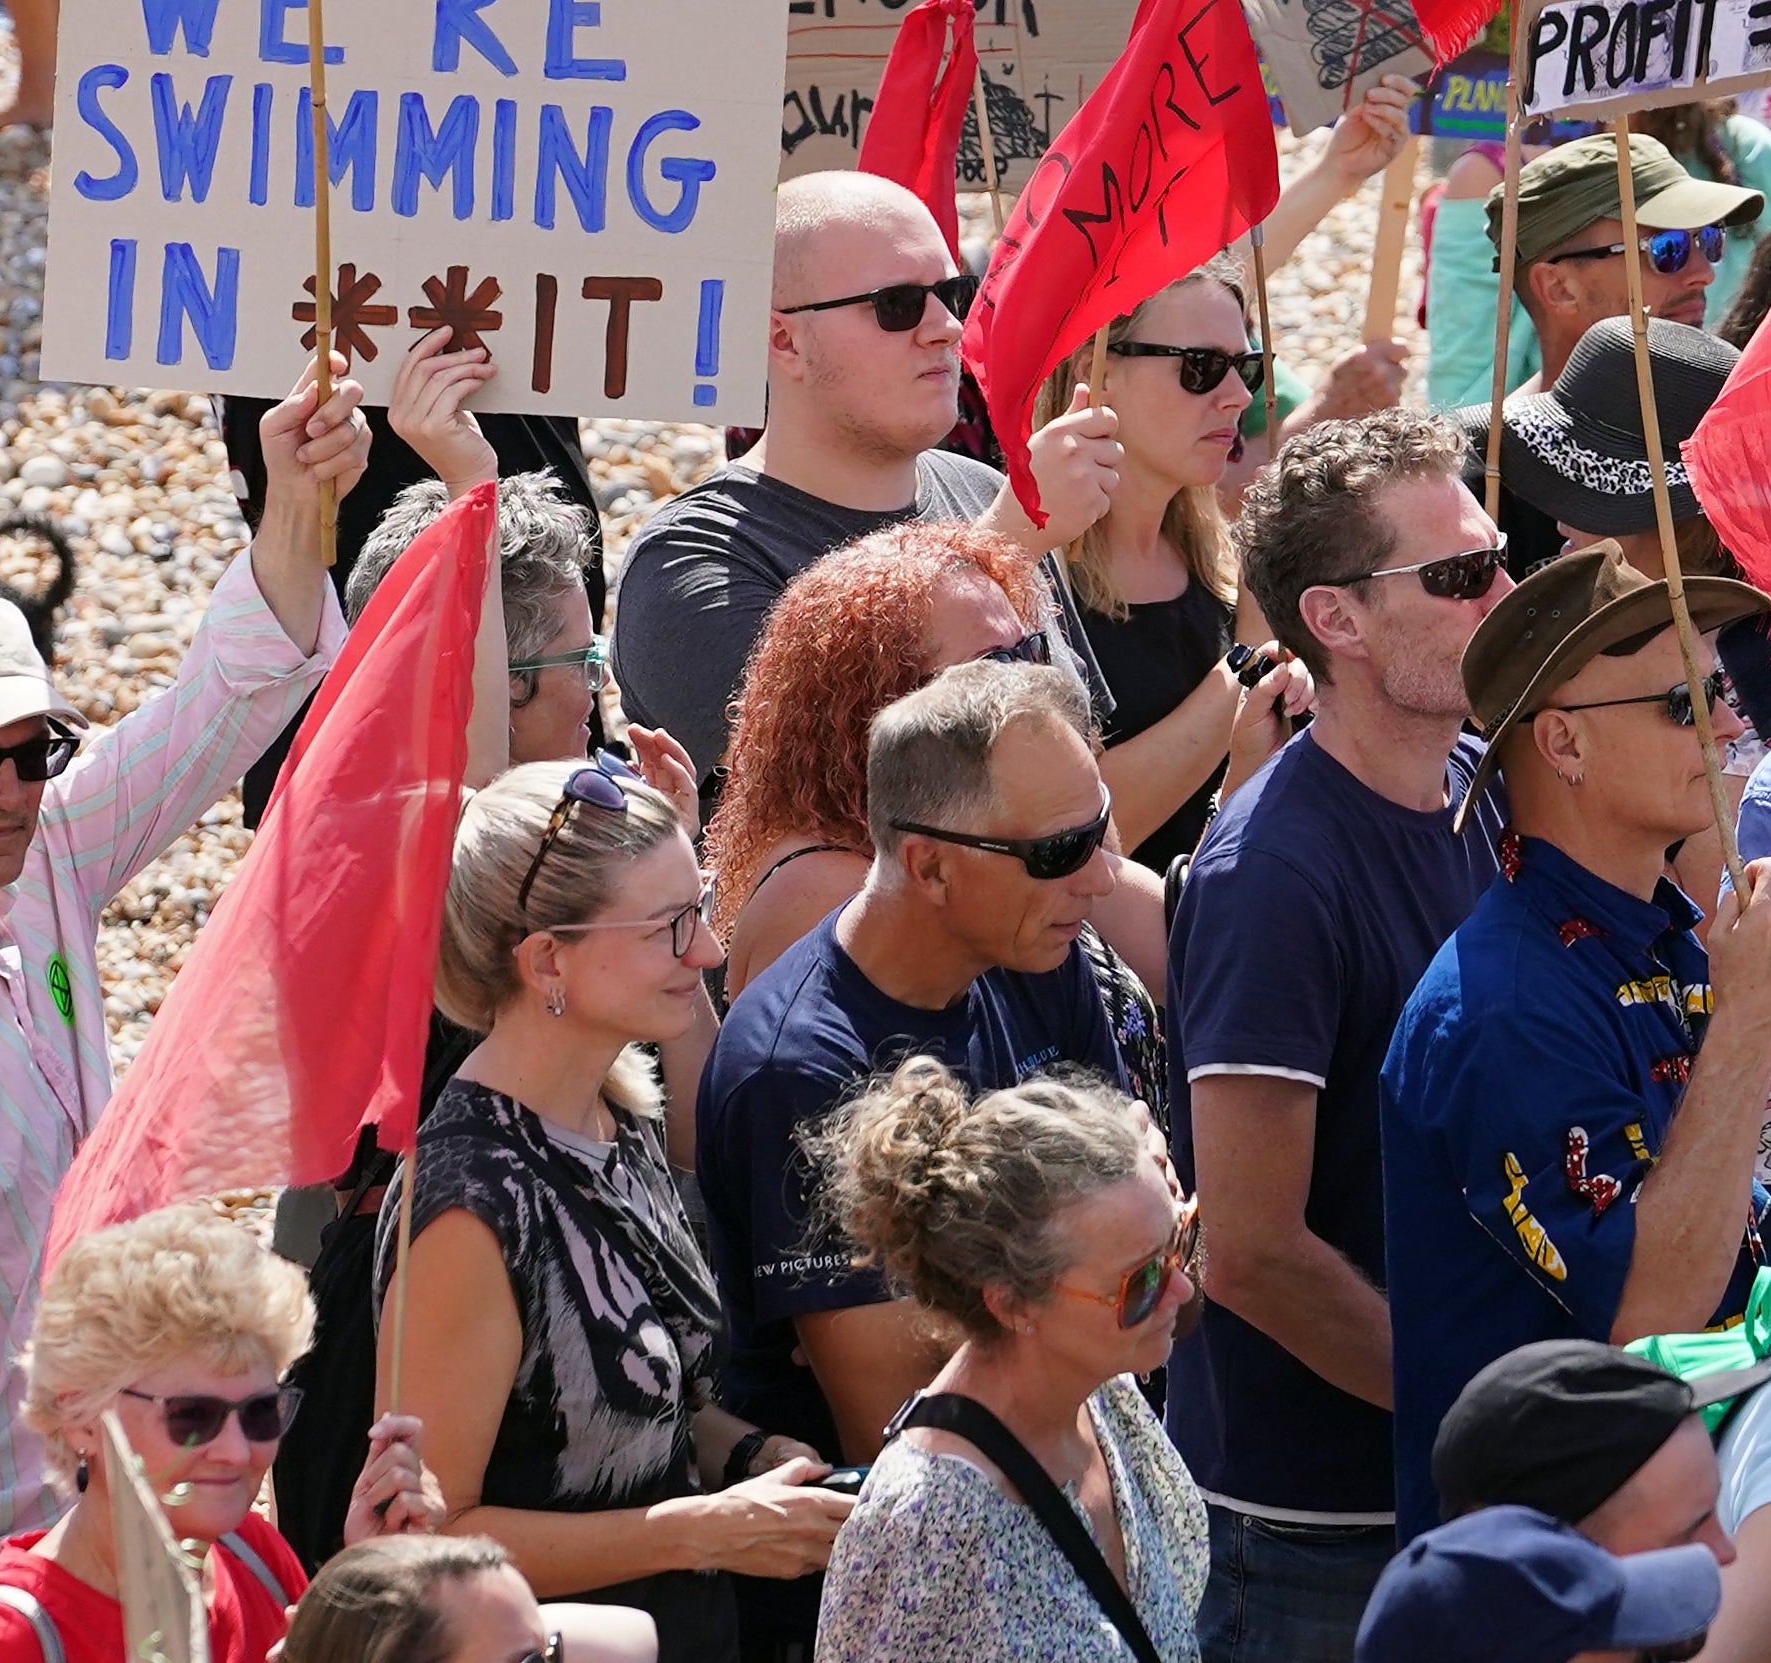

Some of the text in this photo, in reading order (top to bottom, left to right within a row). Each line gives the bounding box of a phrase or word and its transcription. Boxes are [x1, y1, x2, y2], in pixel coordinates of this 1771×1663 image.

[73, 63, 716, 234] SWIMMING
[105, 238, 240, 371] IN
[780, 1254, 850, 1274] PICTURES
